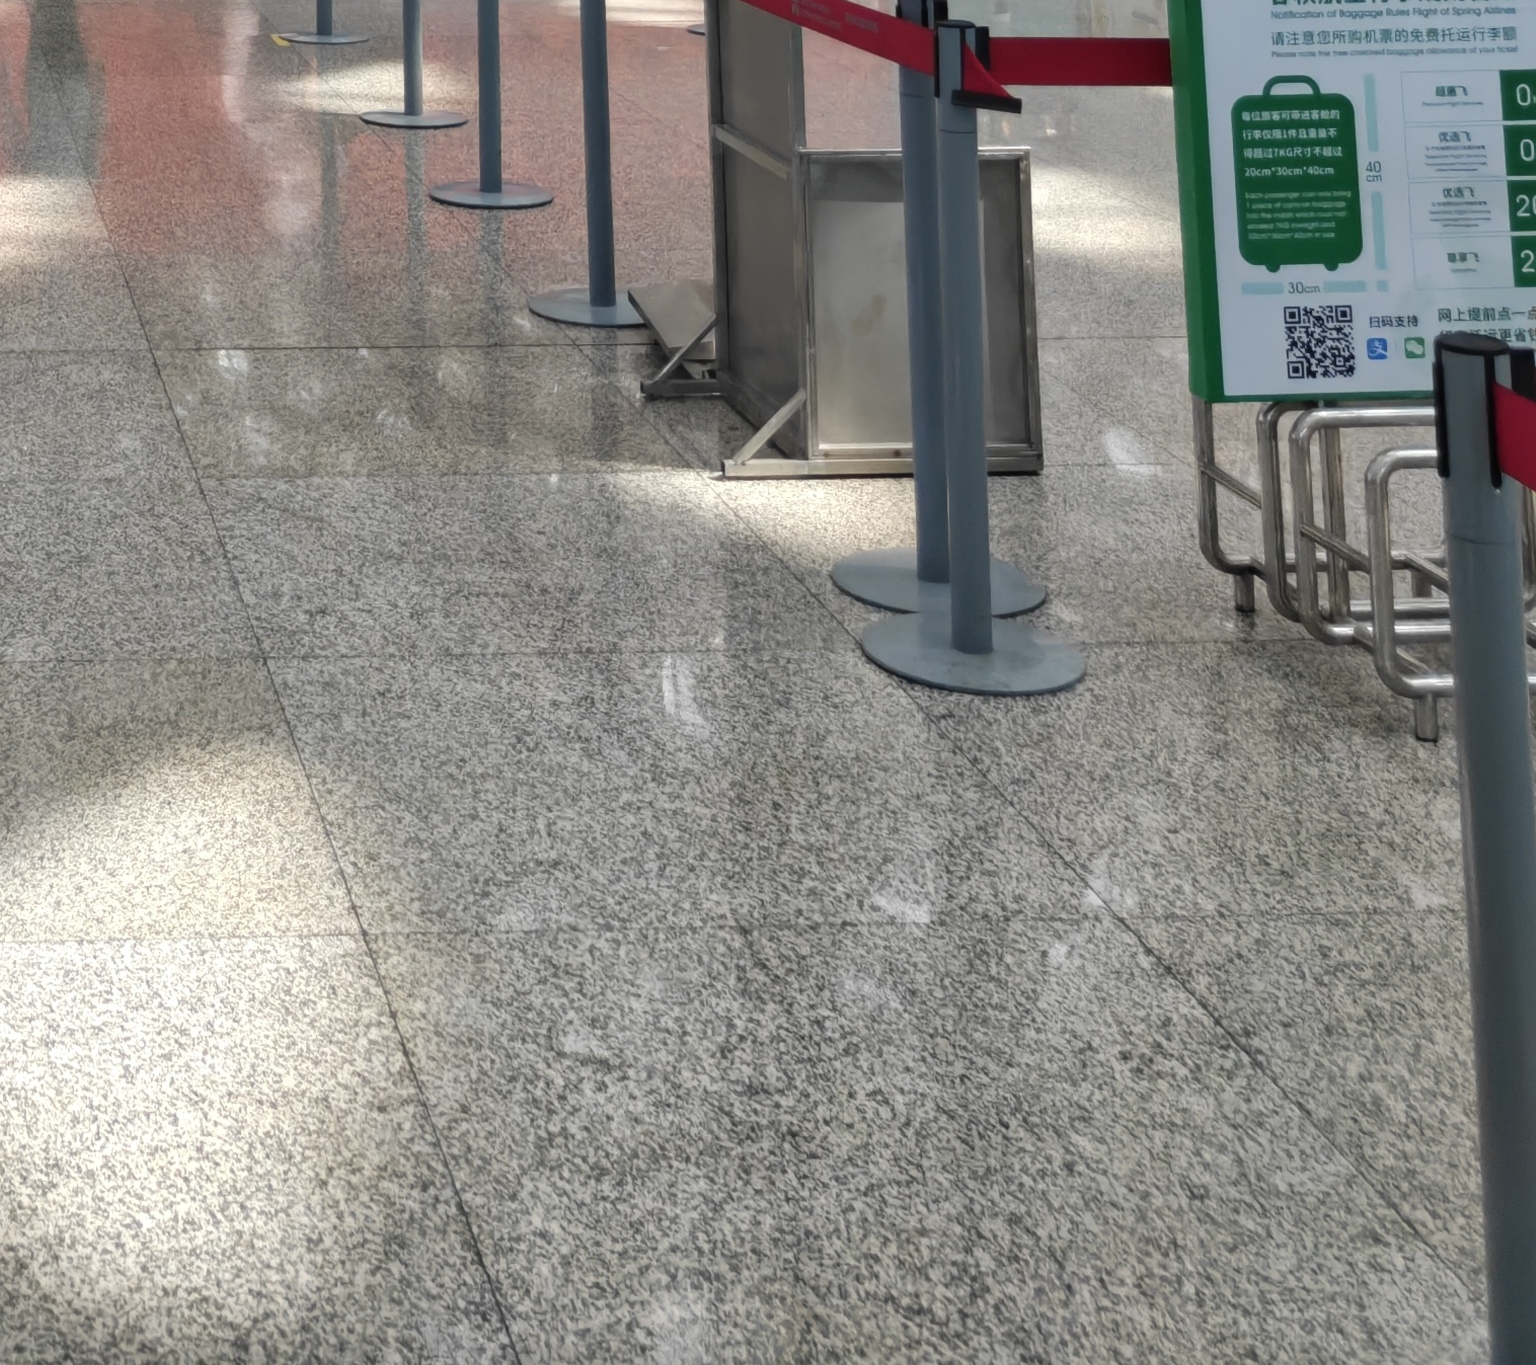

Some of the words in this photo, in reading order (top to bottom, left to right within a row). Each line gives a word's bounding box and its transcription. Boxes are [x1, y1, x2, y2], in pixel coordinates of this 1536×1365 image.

[1366, 161, 1382, 173] 40
[1366, 174, 1382, 182] cm
[1288, 282, 1321, 294] 30cm
[1369, 315, 1418, 328] 扫码支持
